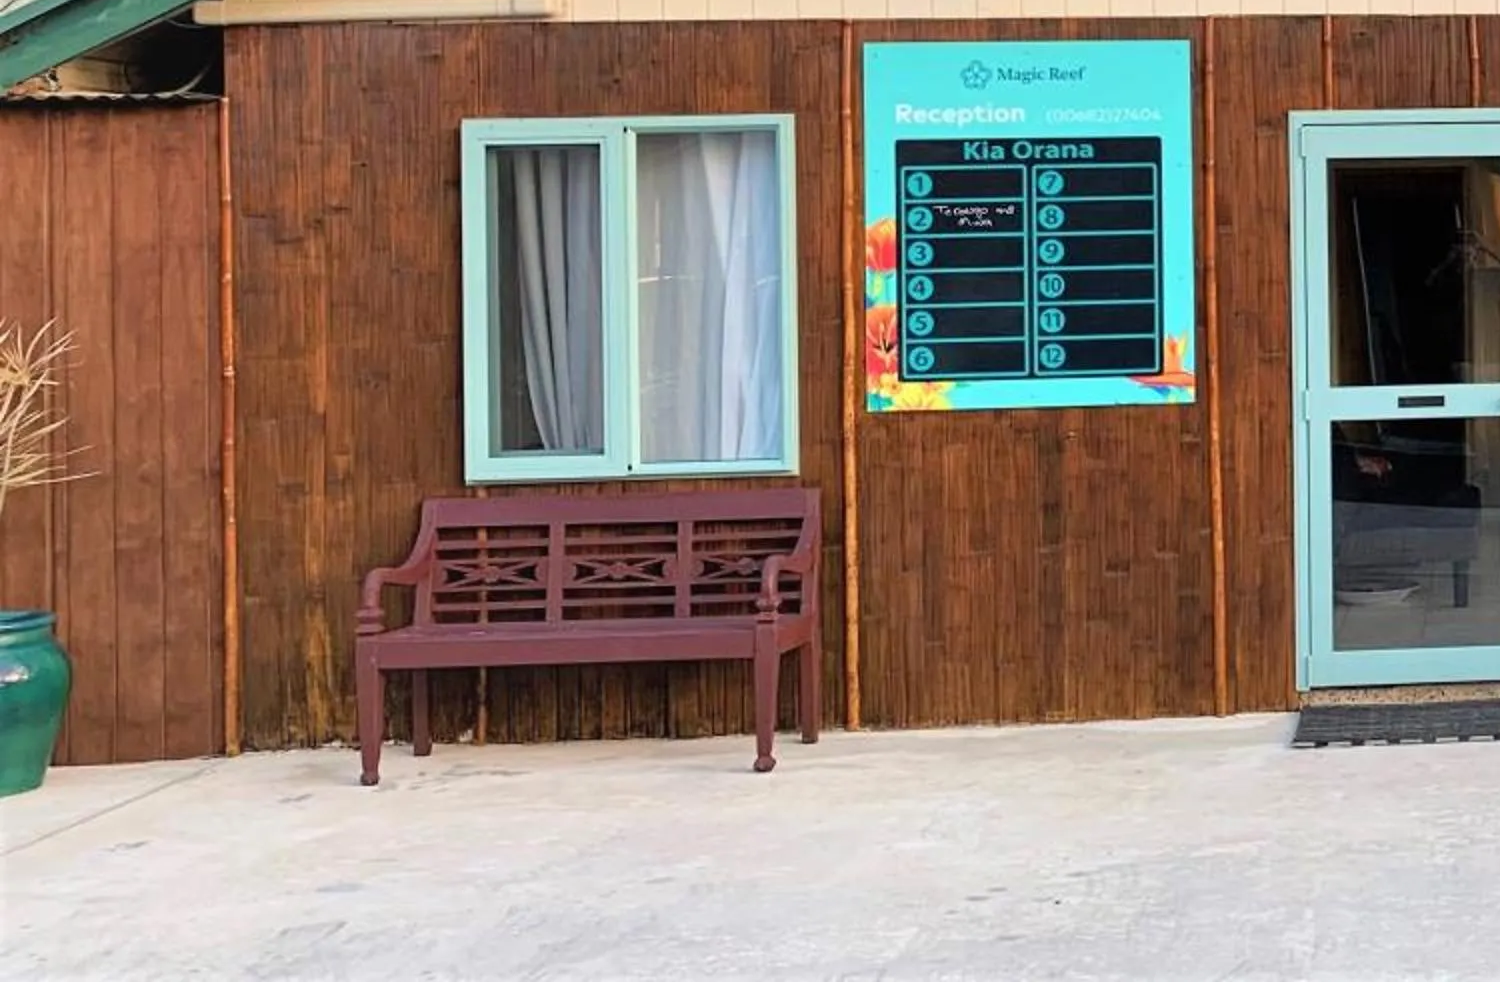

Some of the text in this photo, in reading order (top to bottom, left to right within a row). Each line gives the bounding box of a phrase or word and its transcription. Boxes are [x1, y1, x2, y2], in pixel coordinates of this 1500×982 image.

[997, 67, 1086, 84] Magic Reef
[895, 103, 1026, 126] Reception
[963, 140, 1094, 160] Kia Orana
